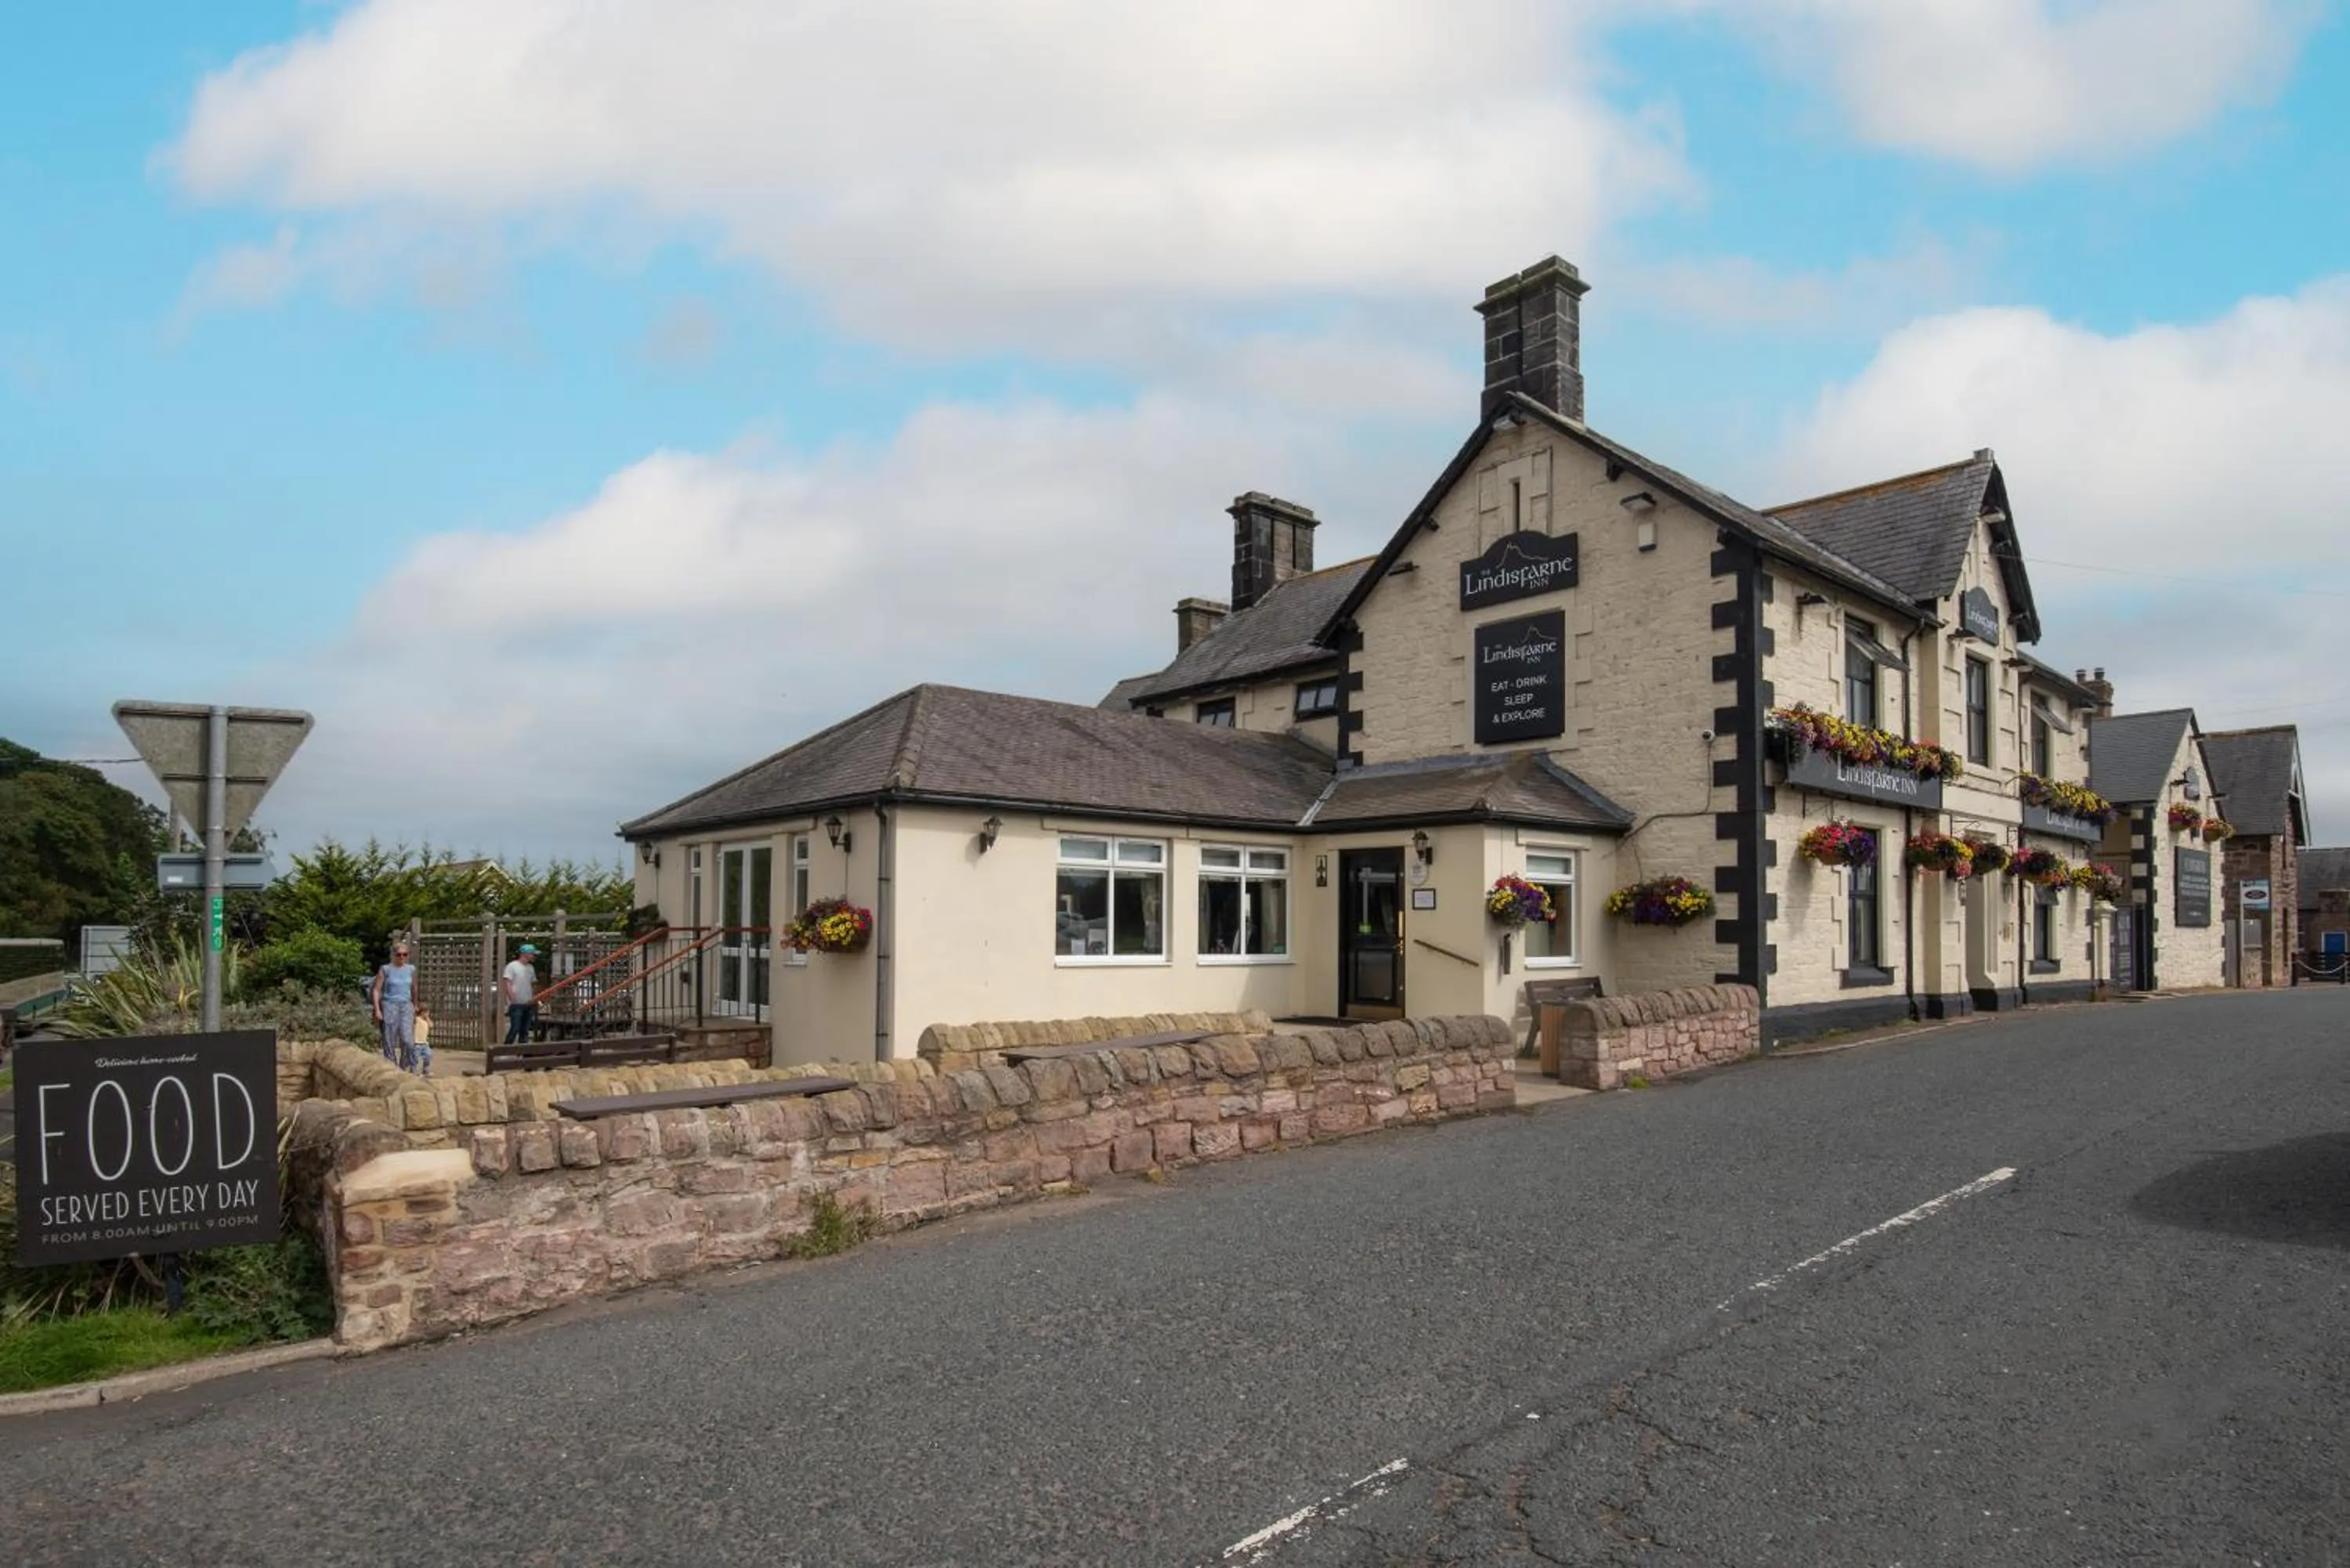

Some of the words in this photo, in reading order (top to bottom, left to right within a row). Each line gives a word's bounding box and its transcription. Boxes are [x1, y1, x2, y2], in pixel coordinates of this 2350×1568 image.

[1529, 576, 1549, 589] INN
[1491, 681, 1509, 692] EAT
[1516, 674, 1548, 688] DRINK
[1504, 693, 1534, 706] SLEEP
[1492, 714, 1500, 723] &
[1502, 707, 1546, 723] EXPLORE
[38, 1073, 255, 1184] FOOD
[41, 1191, 129, 1226] SERVED
[139, 1183, 209, 1217] EVERY
[219, 1179, 259, 1209] DAY
[42, 1231, 87, 1245] FROM
[206, 1215, 258, 1229] 900PM
